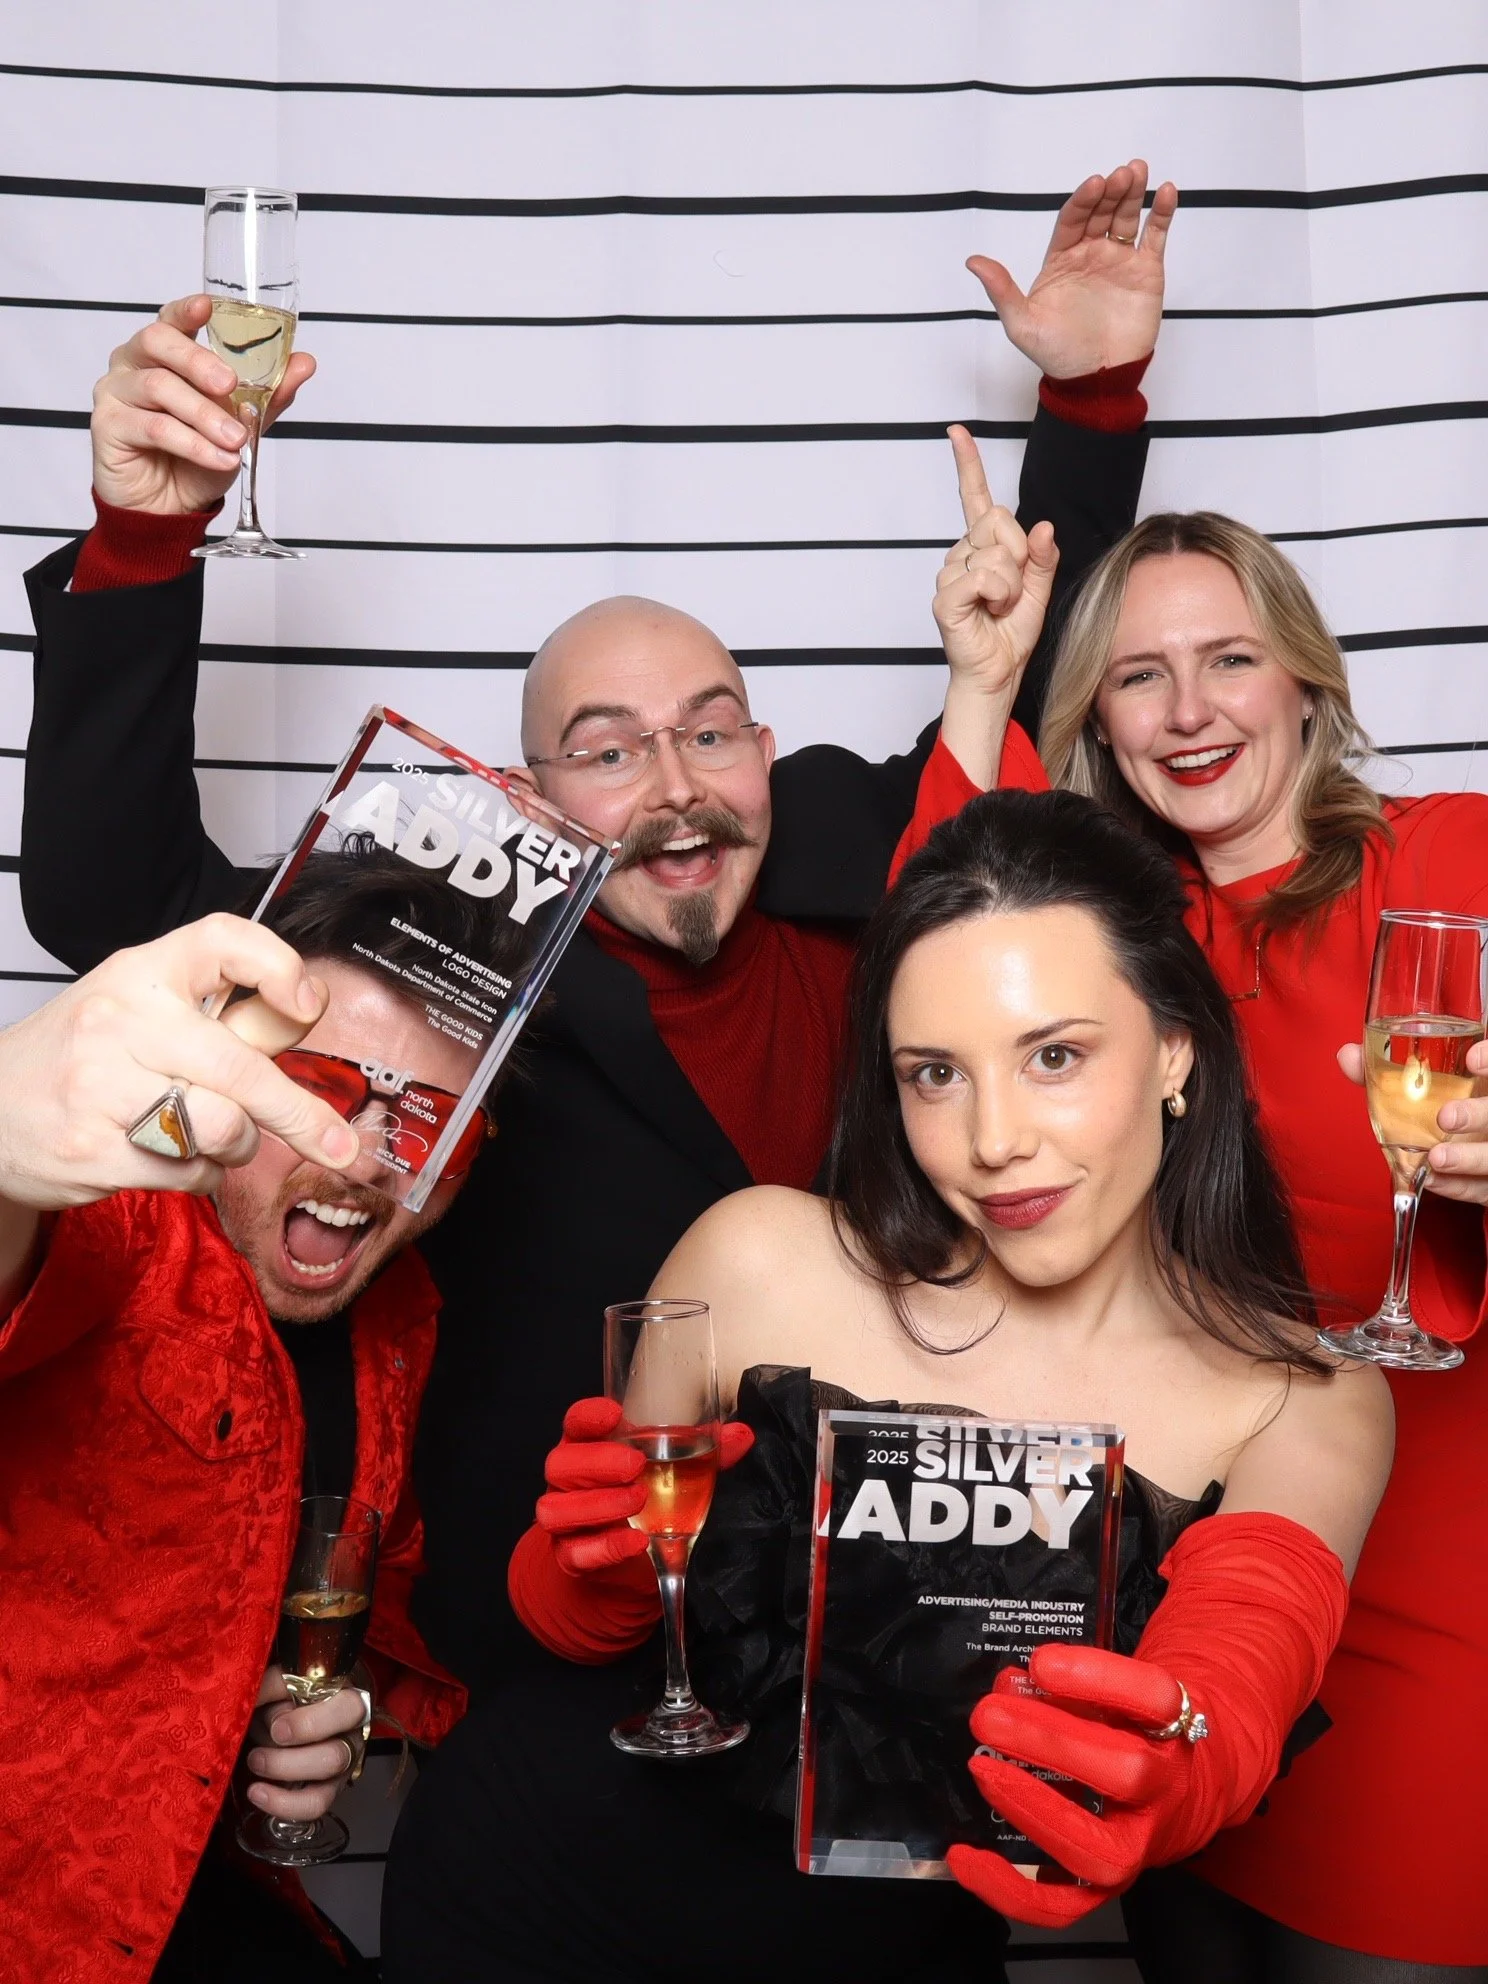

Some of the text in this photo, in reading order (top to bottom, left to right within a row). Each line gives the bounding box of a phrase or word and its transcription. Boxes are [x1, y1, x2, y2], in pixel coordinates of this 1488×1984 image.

[391, 757, 581, 882] 2025 SILVER
[341, 780, 569, 926] ADDY
[390, 917, 513, 989] ELEMENTS OF ADVERTISING
[352, 942, 493, 1024] North Dakota Department of Commerce
[412, 964, 498, 1015] North Dakota State Icon
[442, 958, 508, 1000] LOGO DESIGN
[425, 1004, 484, 1041] THE GOOD KIDS
[427, 1016, 479, 1050] The Good Kids
[400, 1099, 437, 1125] dakota
[405, 1089, 434, 1110] north
[866, 1440, 1093, 1487] 2025 SILVER
[836, 1478, 1094, 1550] ADDY
[917, 1595, 1085, 1612] ADVERTISING/MEDIA INDUSTRY
[988, 1611, 1084, 1624] SELF-PROMOTION
[981, 1623, 1083, 1636] BRAND ELEMENTS
[966, 1642, 1036, 1653] The Brand Archi
[1019, 1655, 1030, 1663] Th
[1009, 1675, 1028, 1684] THE
[1018, 1686, 1033, 1695] The
[997, 1833, 1027, 1842] AAF-ND
